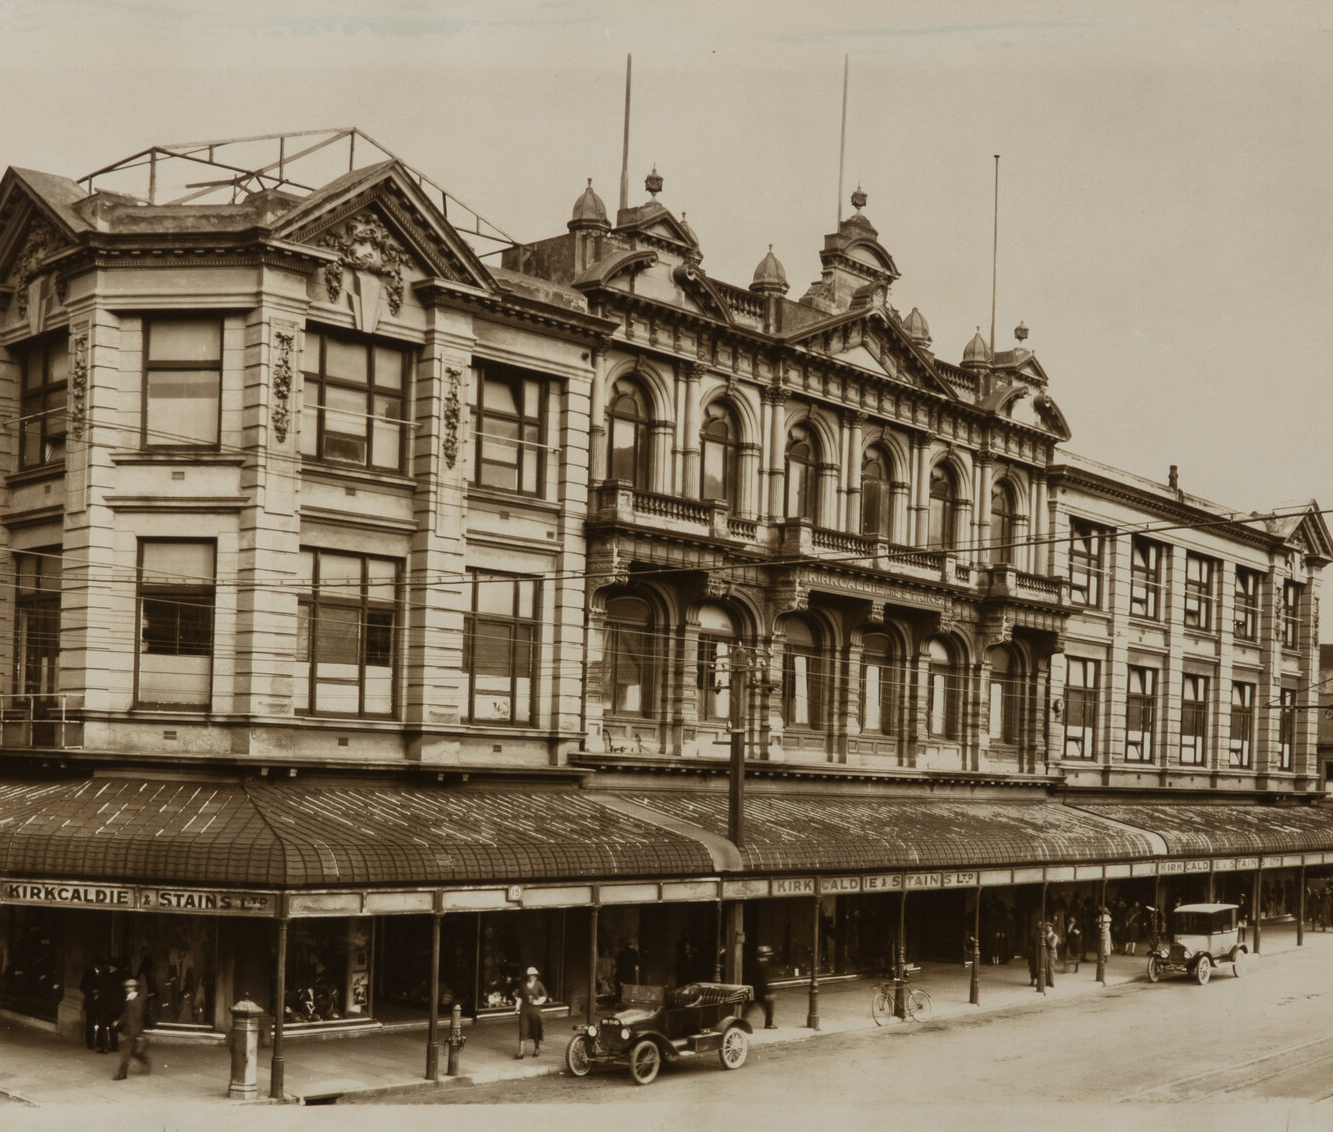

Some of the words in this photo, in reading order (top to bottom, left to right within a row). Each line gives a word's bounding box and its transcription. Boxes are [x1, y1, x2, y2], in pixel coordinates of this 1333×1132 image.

[777, 878, 877, 893] KIRKCALDIE
[891, 874, 952, 887] STAINS
[8, 884, 129, 905] KIRKCALDIE
[143, 893, 150, 906] &
[159, 892, 231, 910] STAINS
